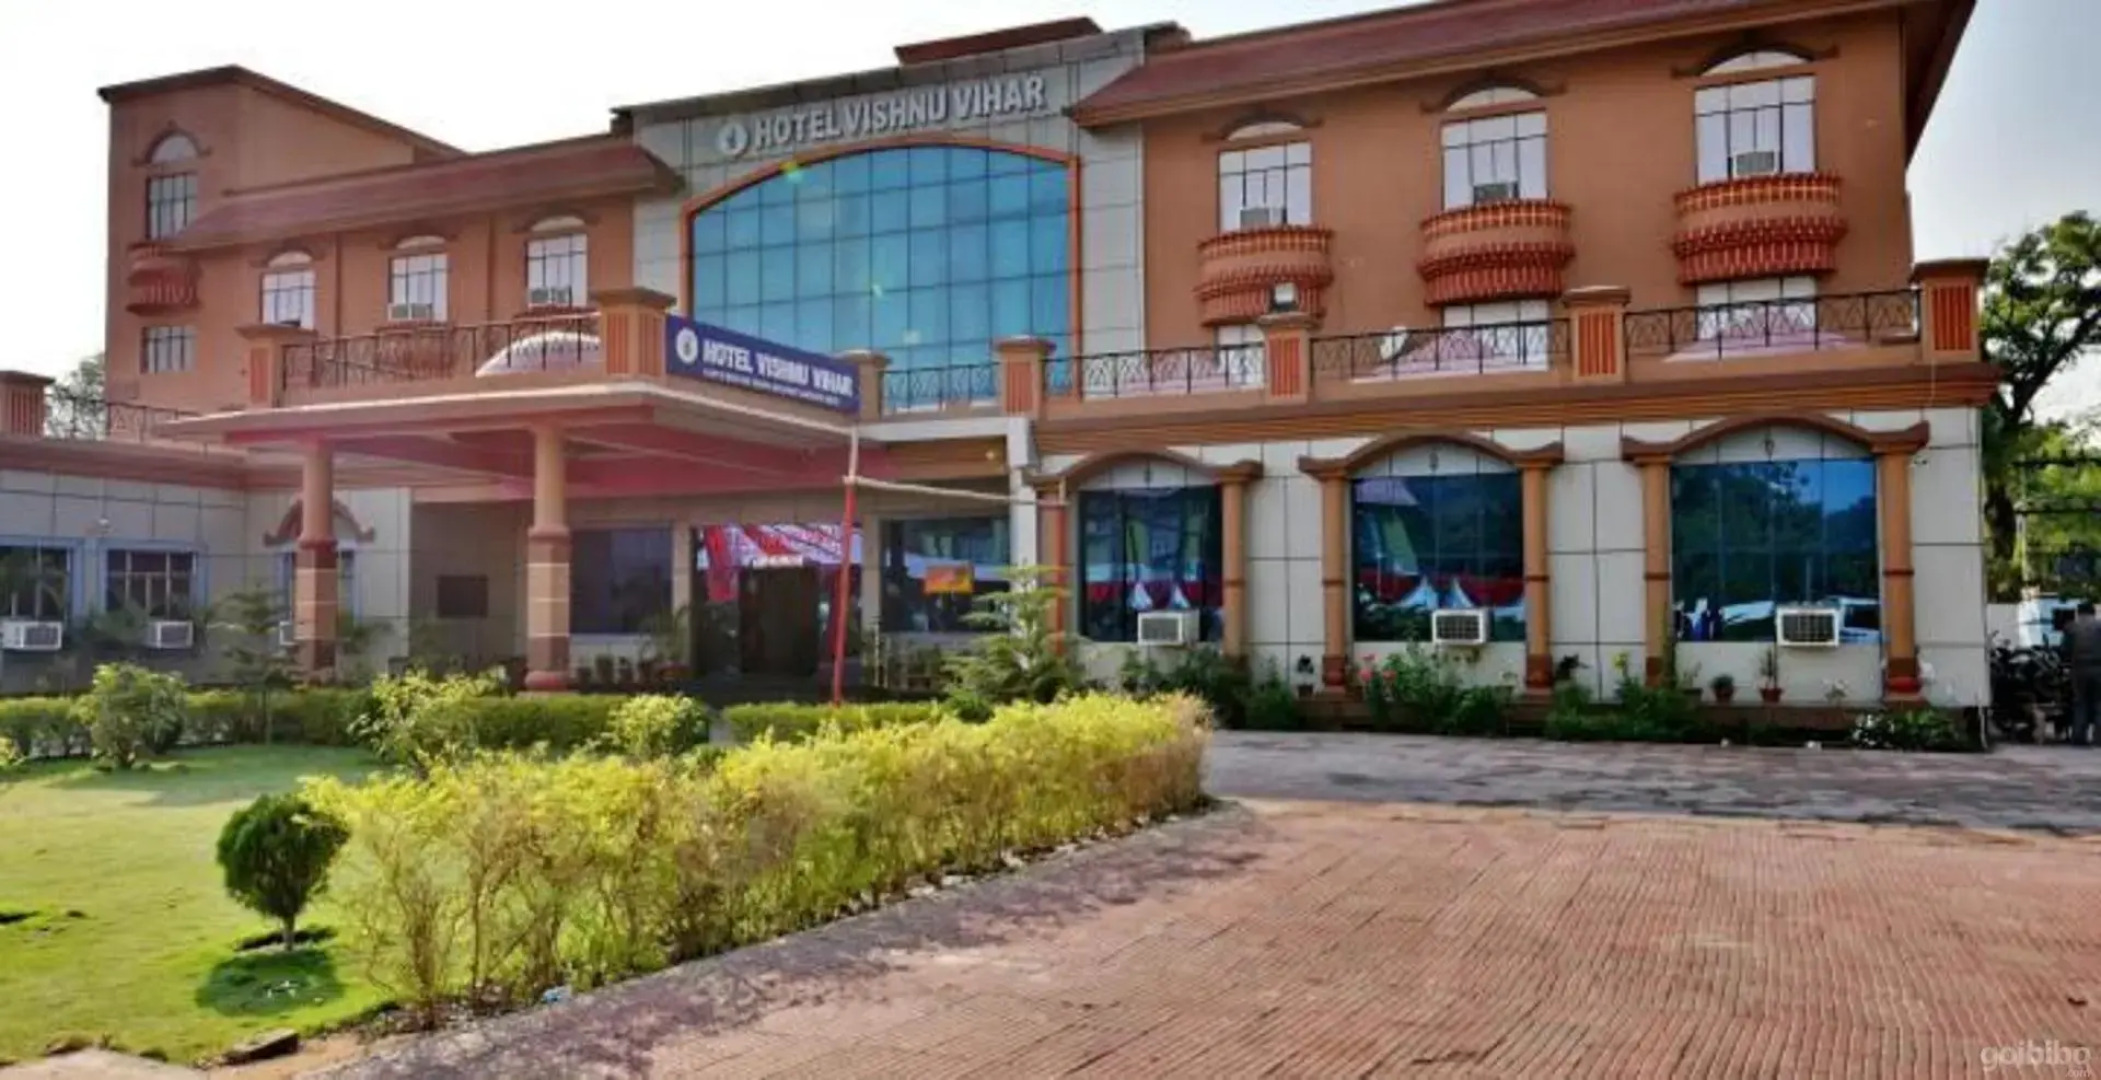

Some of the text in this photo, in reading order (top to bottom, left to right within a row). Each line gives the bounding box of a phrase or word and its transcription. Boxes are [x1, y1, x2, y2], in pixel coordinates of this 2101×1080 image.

[754, 76, 1045, 148] HOTEL VISHNU VIHAR
[702, 340, 753, 373] HOTEL
[755, 352, 809, 386] VISHNU
[811, 366, 854, 398] VIHAR
